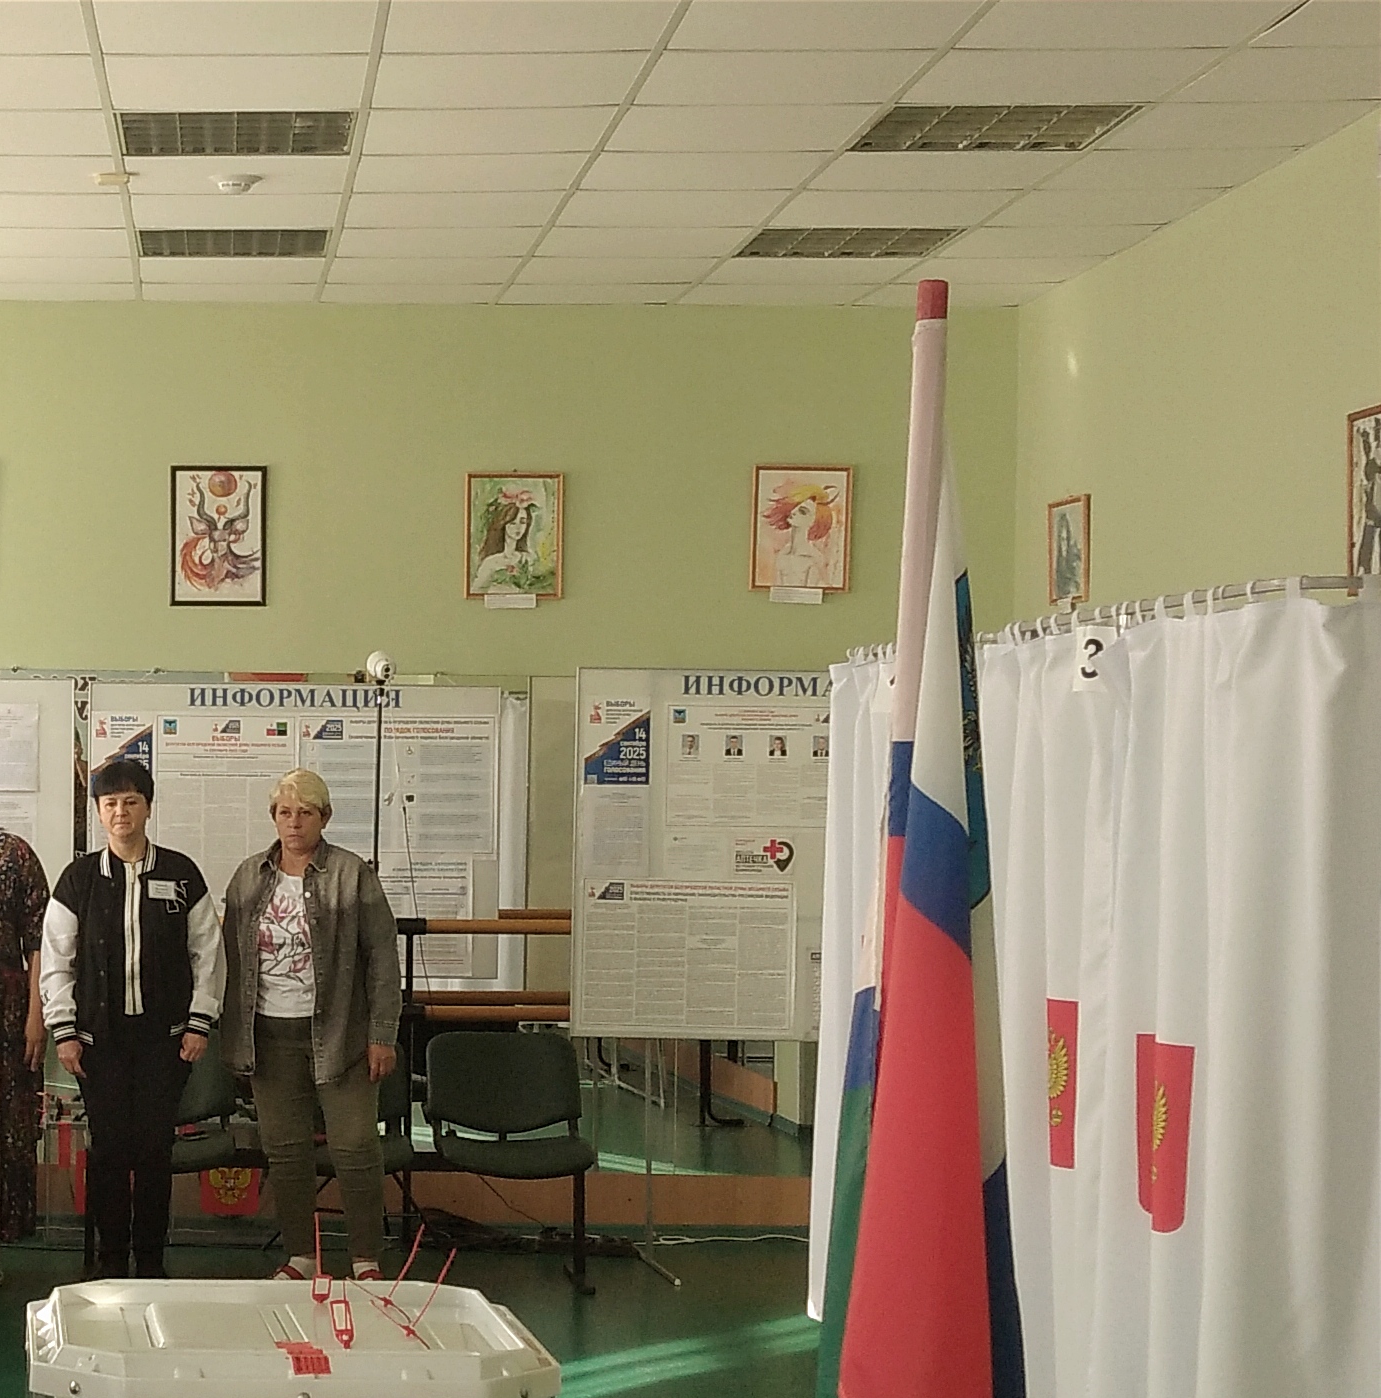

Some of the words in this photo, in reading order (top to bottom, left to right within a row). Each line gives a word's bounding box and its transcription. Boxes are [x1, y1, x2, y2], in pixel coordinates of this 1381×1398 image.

[188, 687, 403, 711] ИНФОРМАЦИЯ
[634, 727, 646, 740] 14
[137, 741, 149, 752] 14
[619, 747, 646, 759] 2025
